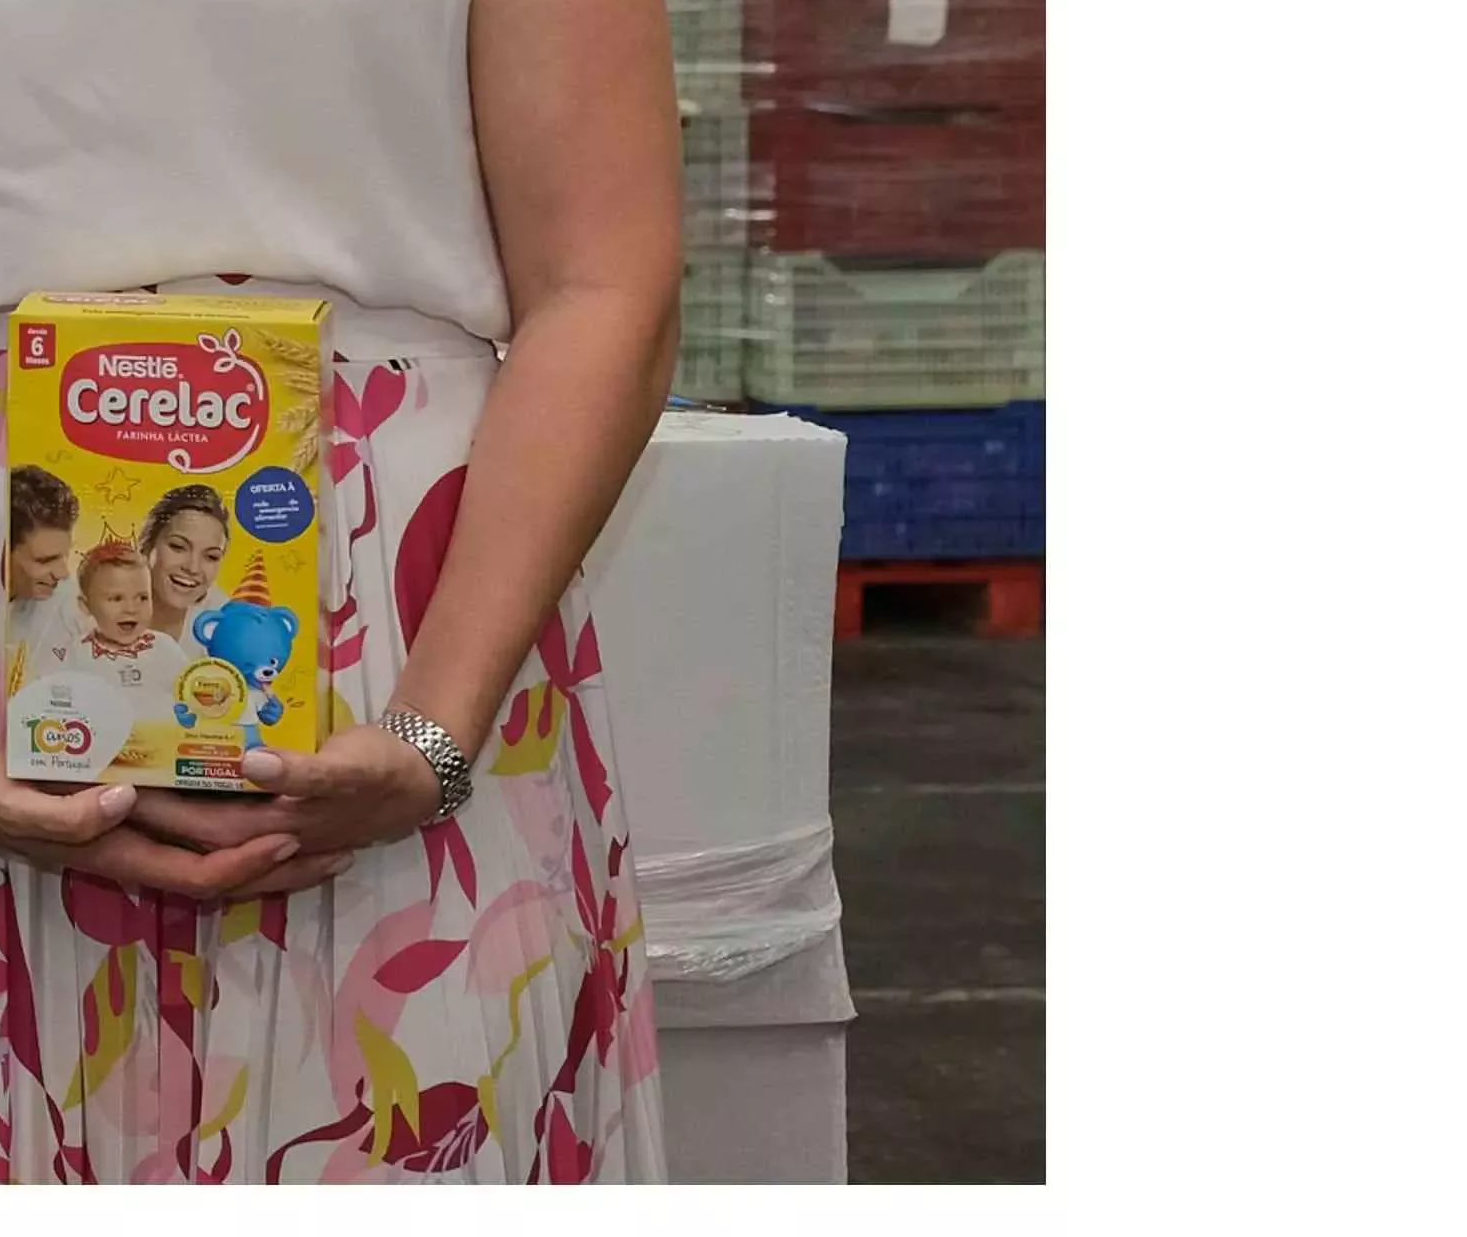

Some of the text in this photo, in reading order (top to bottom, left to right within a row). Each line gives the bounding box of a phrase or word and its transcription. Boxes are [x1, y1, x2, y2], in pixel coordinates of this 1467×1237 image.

[31, 337, 43, 356] 6
[99, 354, 177, 378] Nestlé
[67, 378, 252, 429] Cerelac
[117, 428, 209, 443] FARINHA LÁCTEA
[181, 765, 238, 778] PORTUGAL
